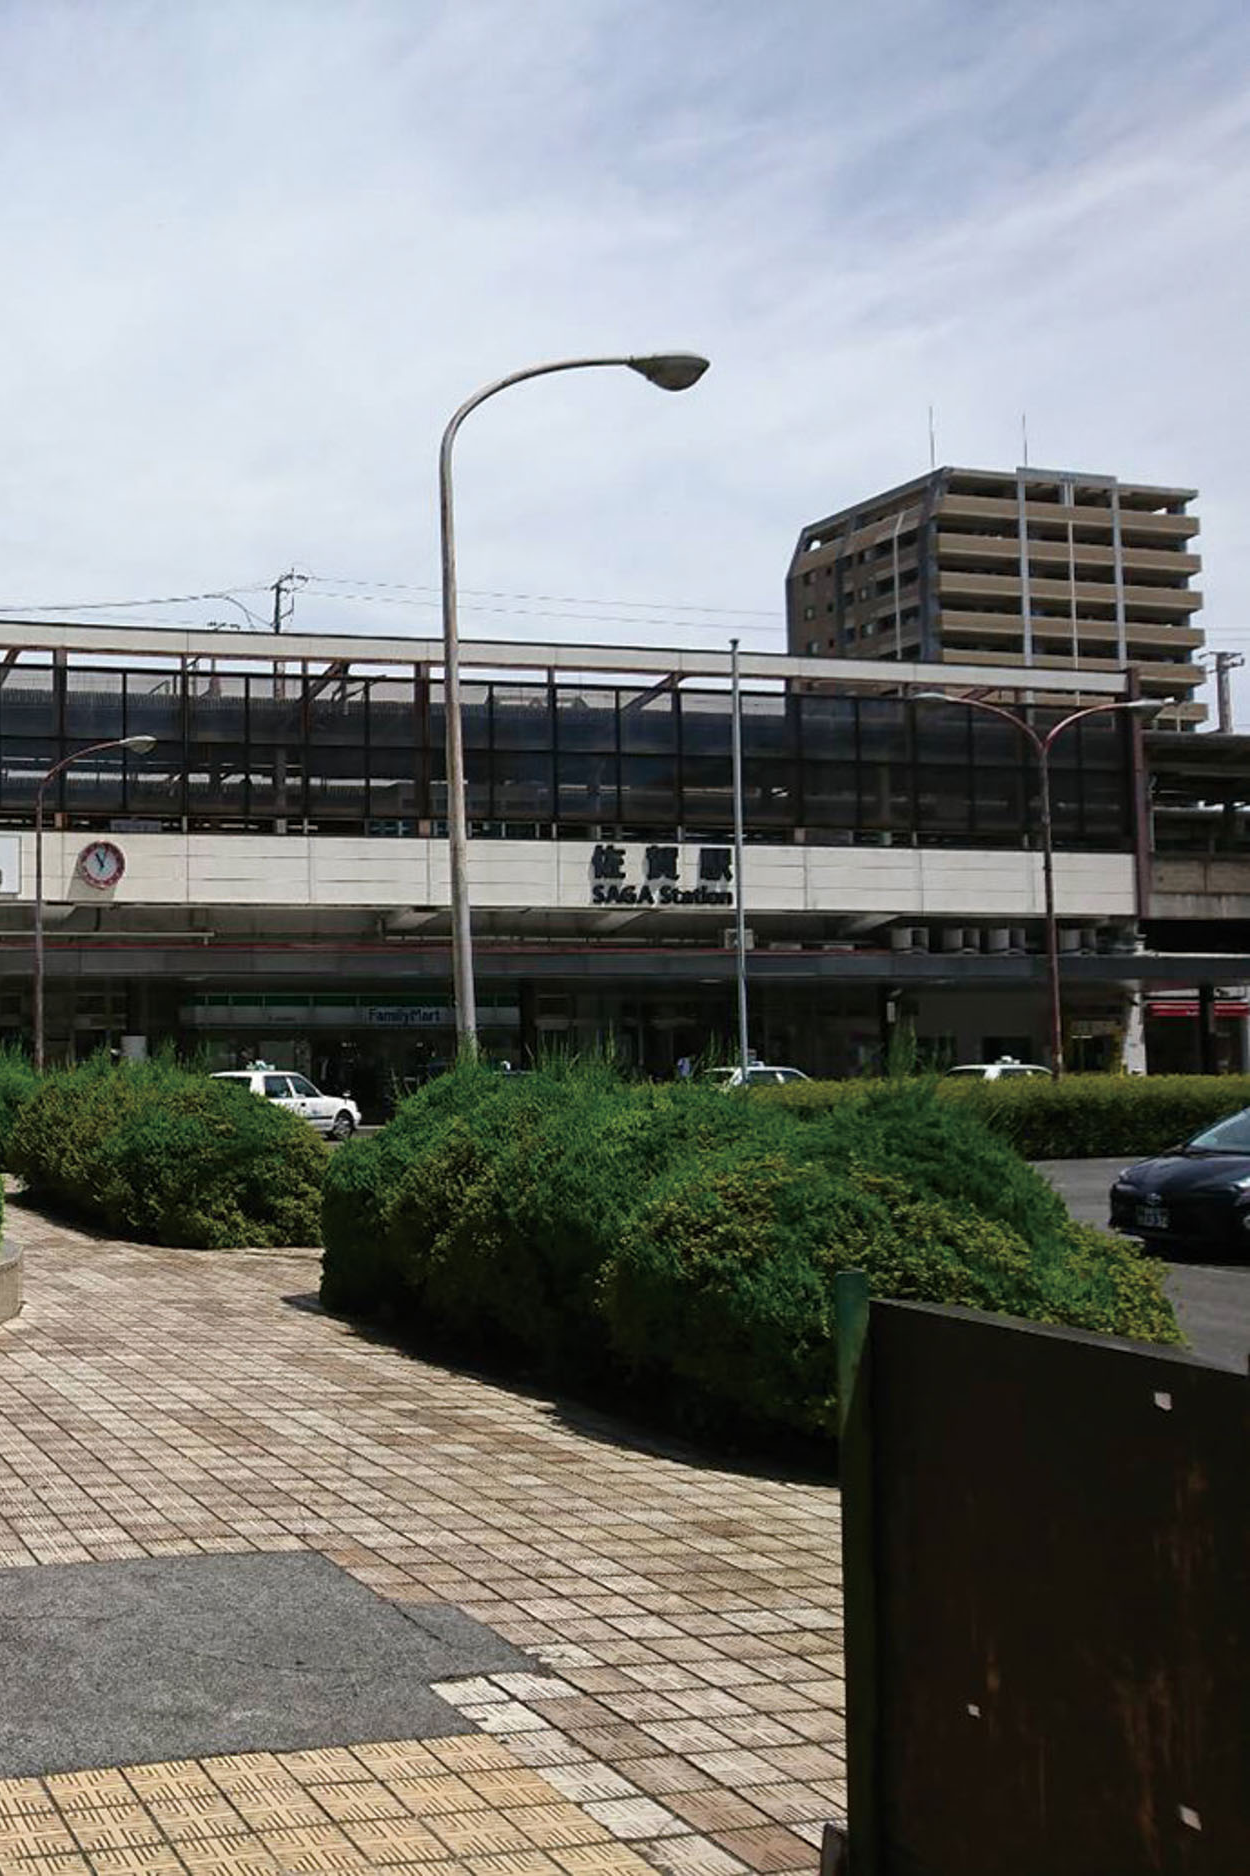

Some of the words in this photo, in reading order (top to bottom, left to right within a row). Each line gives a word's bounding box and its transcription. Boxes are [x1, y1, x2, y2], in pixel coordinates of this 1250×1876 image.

[592, 845, 732, 881] 佐賀駅
[593, 884, 654, 904] SAGA
[660, 884, 732, 904] Station
[368, 1008, 440, 1024] FamilyMart
